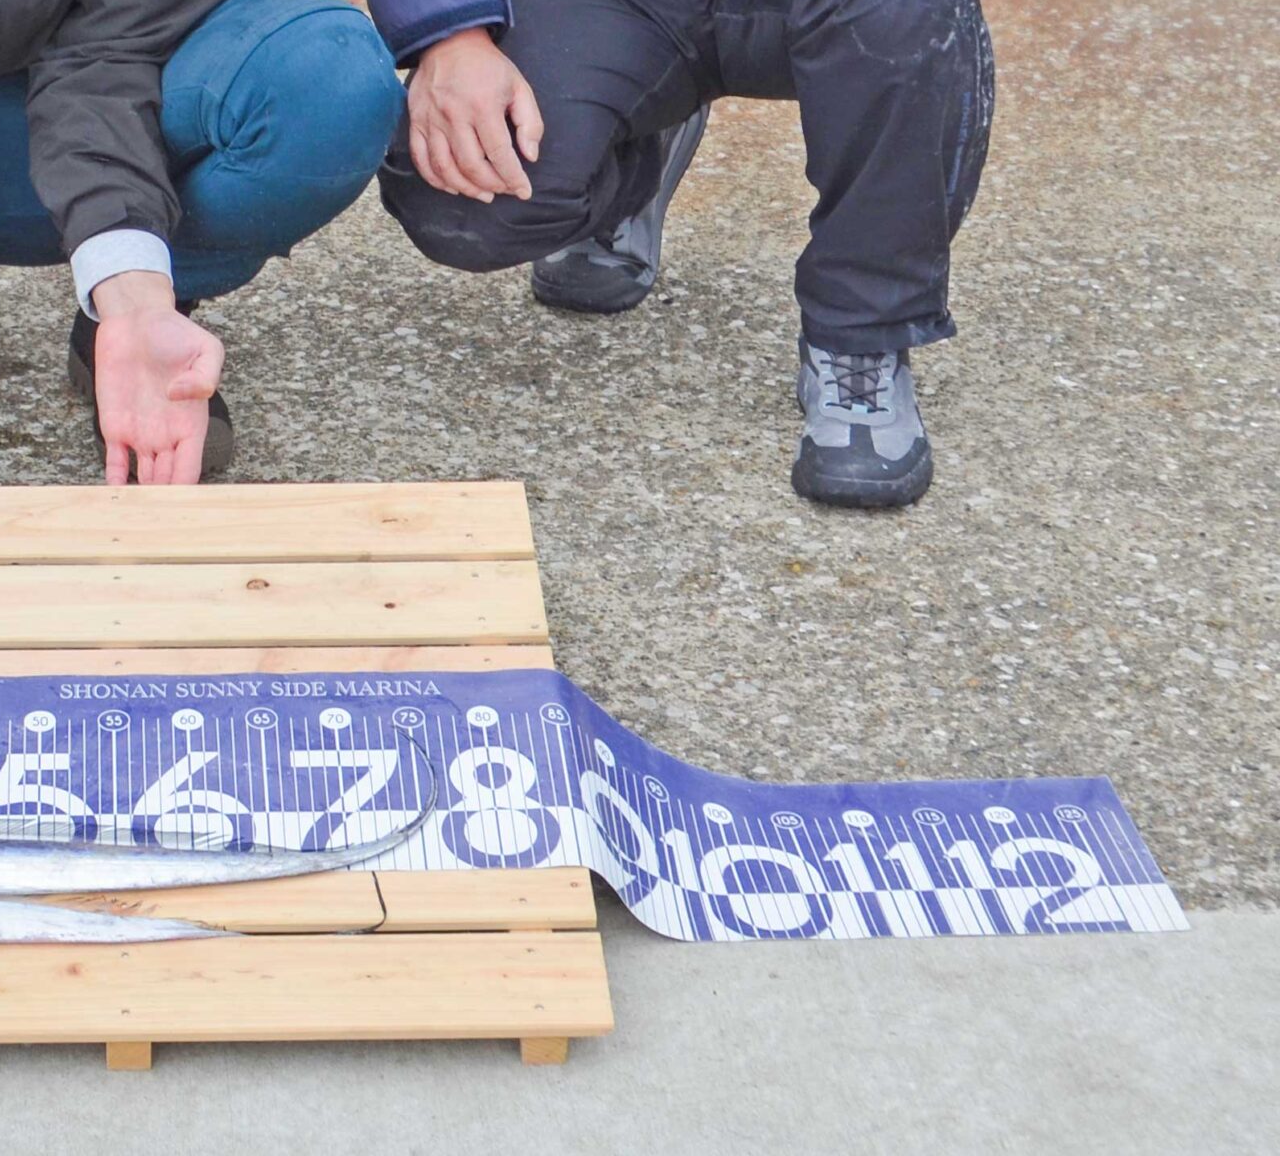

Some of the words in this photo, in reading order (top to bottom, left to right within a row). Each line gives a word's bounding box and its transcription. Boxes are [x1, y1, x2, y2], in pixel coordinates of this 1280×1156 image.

[59, 682, 168, 700] SHONAN
[175, 681, 264, 699] SUNNY
[270, 680, 328, 698] SIDE
[334, 679, 442, 697] MARINA
[132, 751, 256, 853] 6
[289, 749, 399, 853] 7
[441, 746, 561, 868] 8
